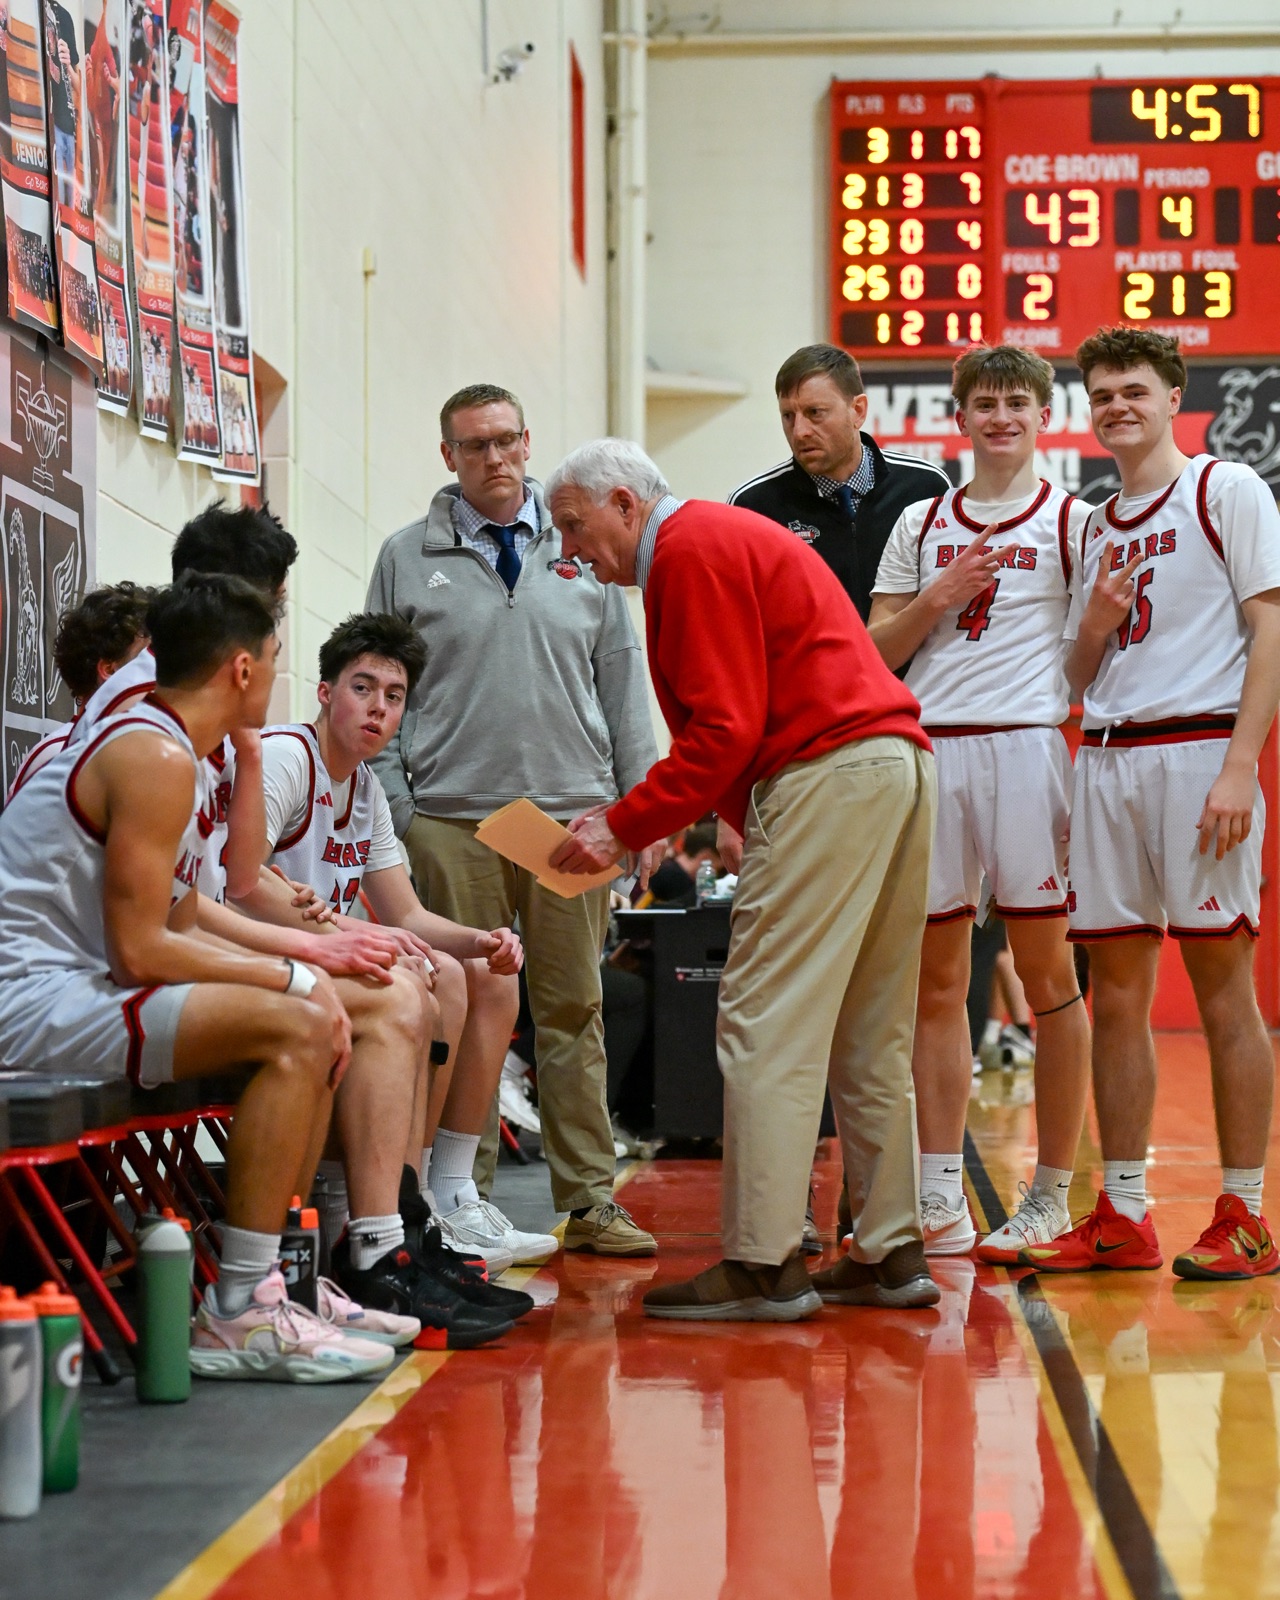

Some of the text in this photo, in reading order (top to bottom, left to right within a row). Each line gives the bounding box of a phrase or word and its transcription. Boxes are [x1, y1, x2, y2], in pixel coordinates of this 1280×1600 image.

[946, 93, 975, 113] PTS
[1131, 84, 1260, 142] 4:57
[867, 126, 981, 164] 3 1 17
[1004, 153, 1139, 184] COE-BROWN
[1143, 166, 1211, 190] PERIOD
[1256, 150, 1280, 182] G
[842, 171, 981, 210] 21 3 7
[1025, 189, 1100, 248] 43
[1162, 196, 1193, 237] 4
[842, 218, 981, 256] 23 0 4
[1001, 253, 1061, 273] FOULS
[1114, 250, 1240, 272] PLAYER FOUL
[842, 263, 982, 301] 25 0 0
[1023, 273, 1054, 321] 2
[877, 310, 982, 346] 1 2 11
[1002, 327, 1062, 348] SCORE
[1099, 528, 1176, 573] EARS
[956, 578, 1001, 641] 4
